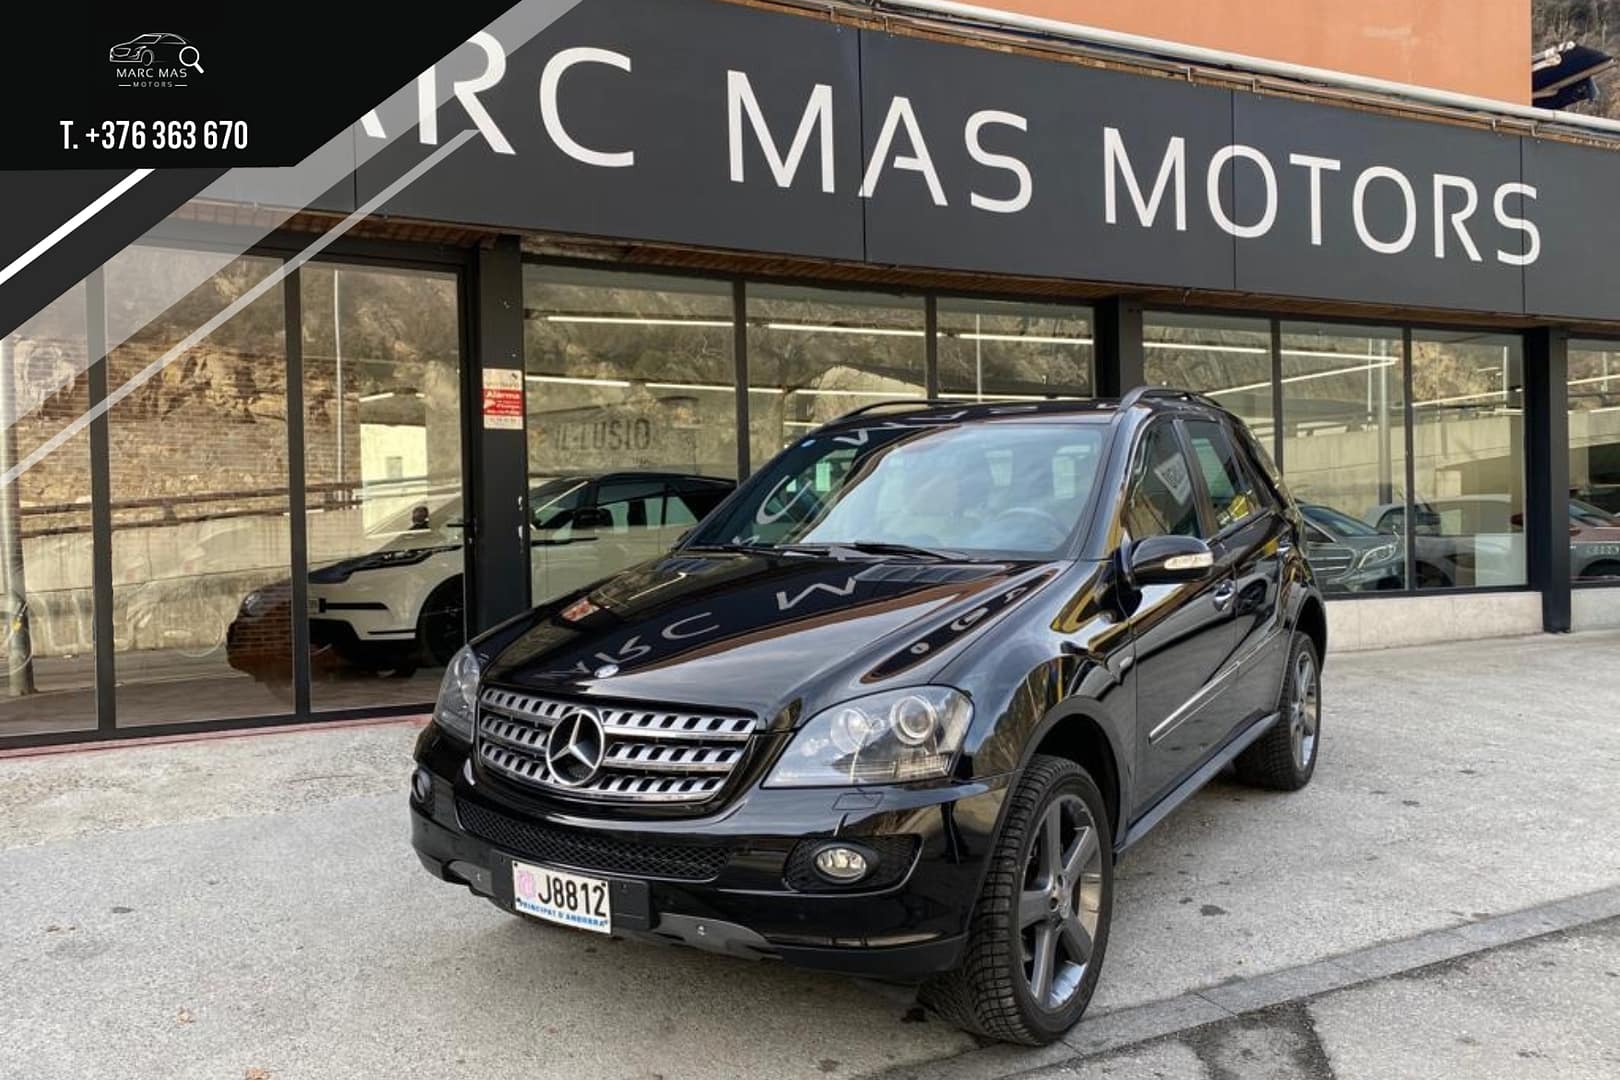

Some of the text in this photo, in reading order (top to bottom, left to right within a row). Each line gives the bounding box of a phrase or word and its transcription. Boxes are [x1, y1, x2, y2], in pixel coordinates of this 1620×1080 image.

[359, 30, 1541, 267] RC MAS MOTORS
[538, 874, 607, 918] J8812
